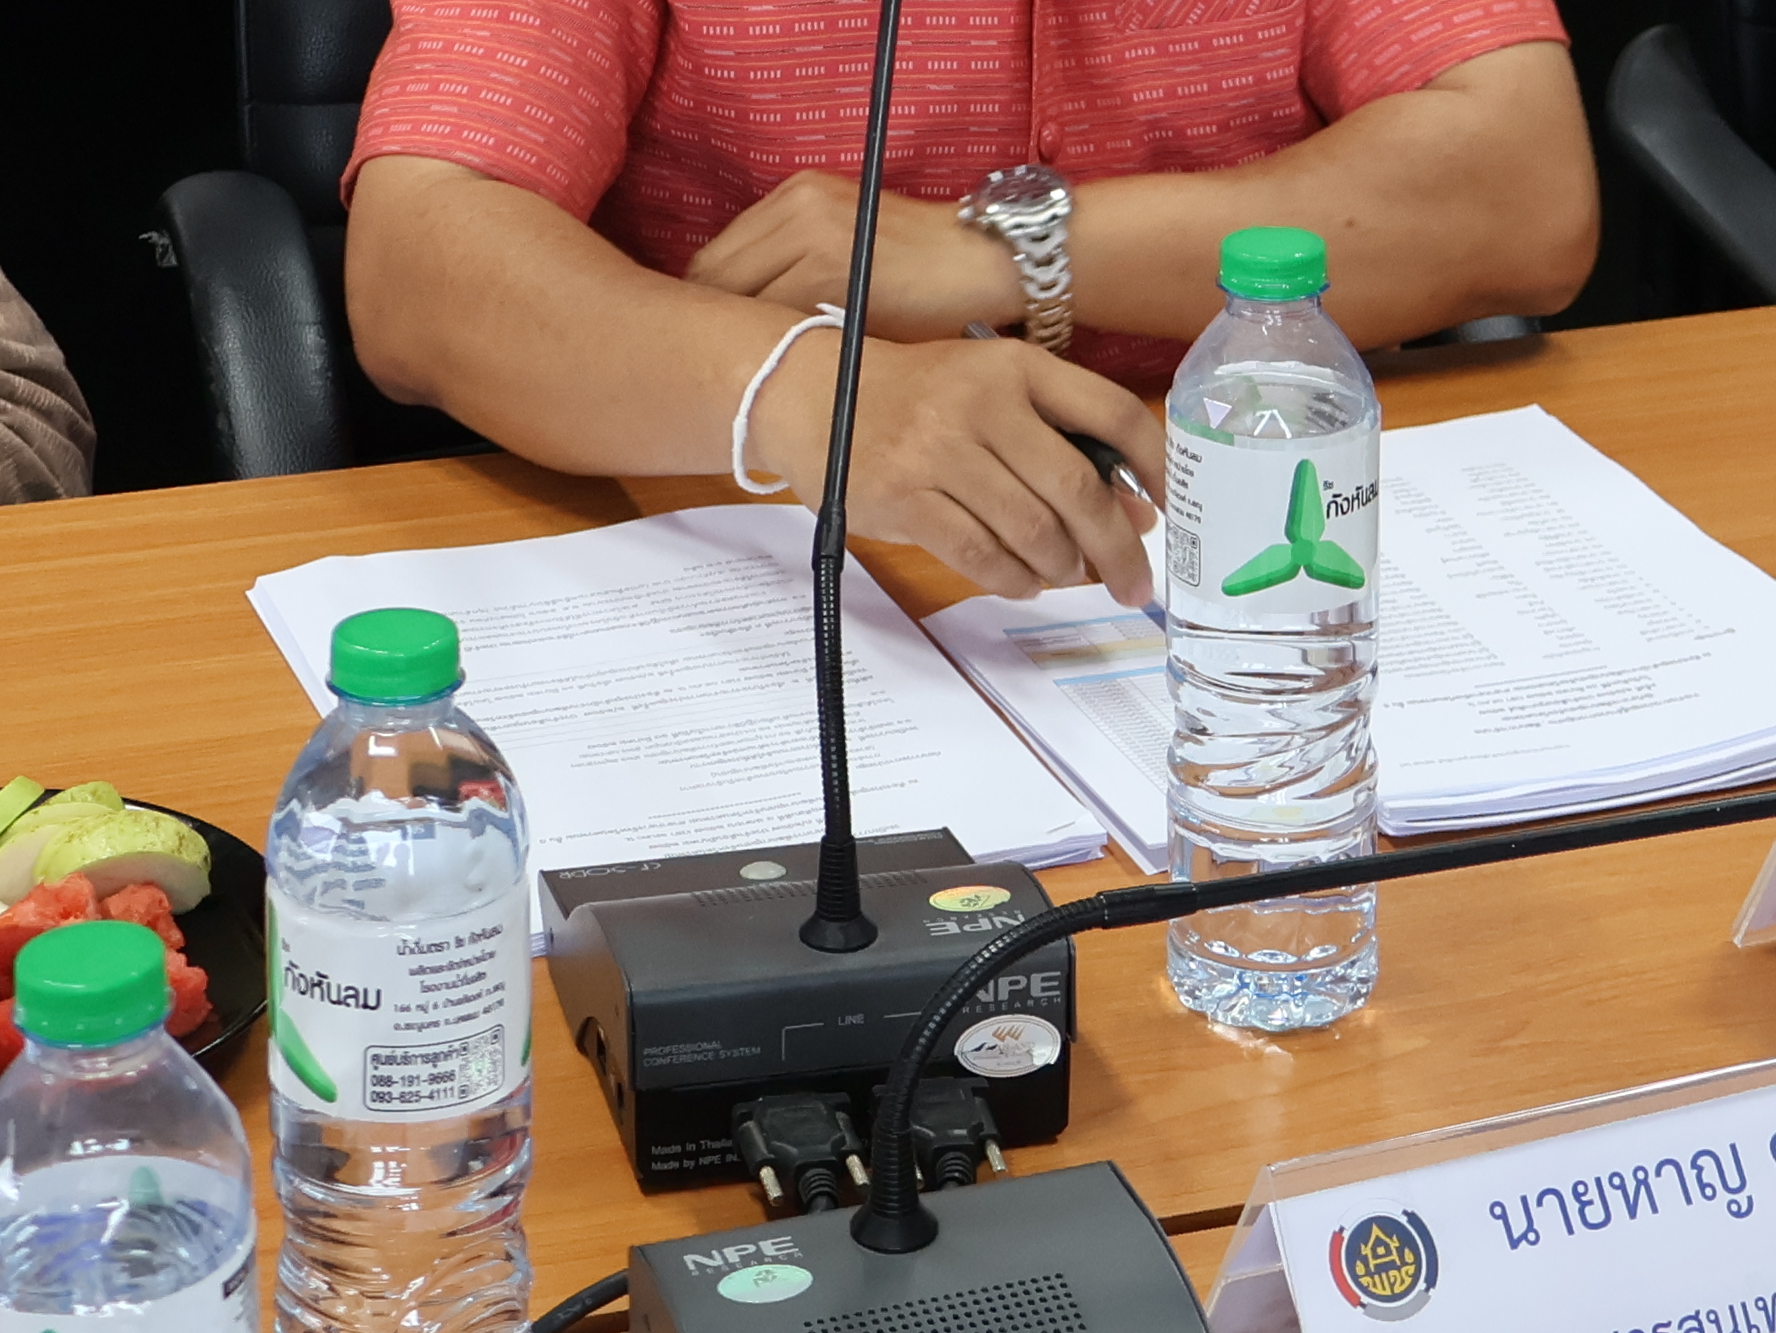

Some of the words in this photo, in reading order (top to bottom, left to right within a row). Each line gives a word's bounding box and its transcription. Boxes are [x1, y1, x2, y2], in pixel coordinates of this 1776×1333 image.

[925, 911, 1028, 937] NPE
[283, 959, 383, 1011] กังหันลม
[975, 970, 1063, 1004] NPE
[961, 996, 1064, 1015] RESEARCH
[837, 1012, 866, 1027] LINE
[642, 1051, 715, 1068] CONFERENCE
[718, 1045, 762, 1060] SYSTEM
[643, 1039, 723, 1057] PROFESSIONAL
[651, 1144, 683, 1156] Made
[685, 1142, 697, 1152] in
[651, 1159, 680, 1171] Made
[683, 1157, 696, 1171] by
[698, 1154, 722, 1167] NPE
[1489, 1144, 1752, 1256] นายหาญ
[682, 1235, 800, 1272] NPE
